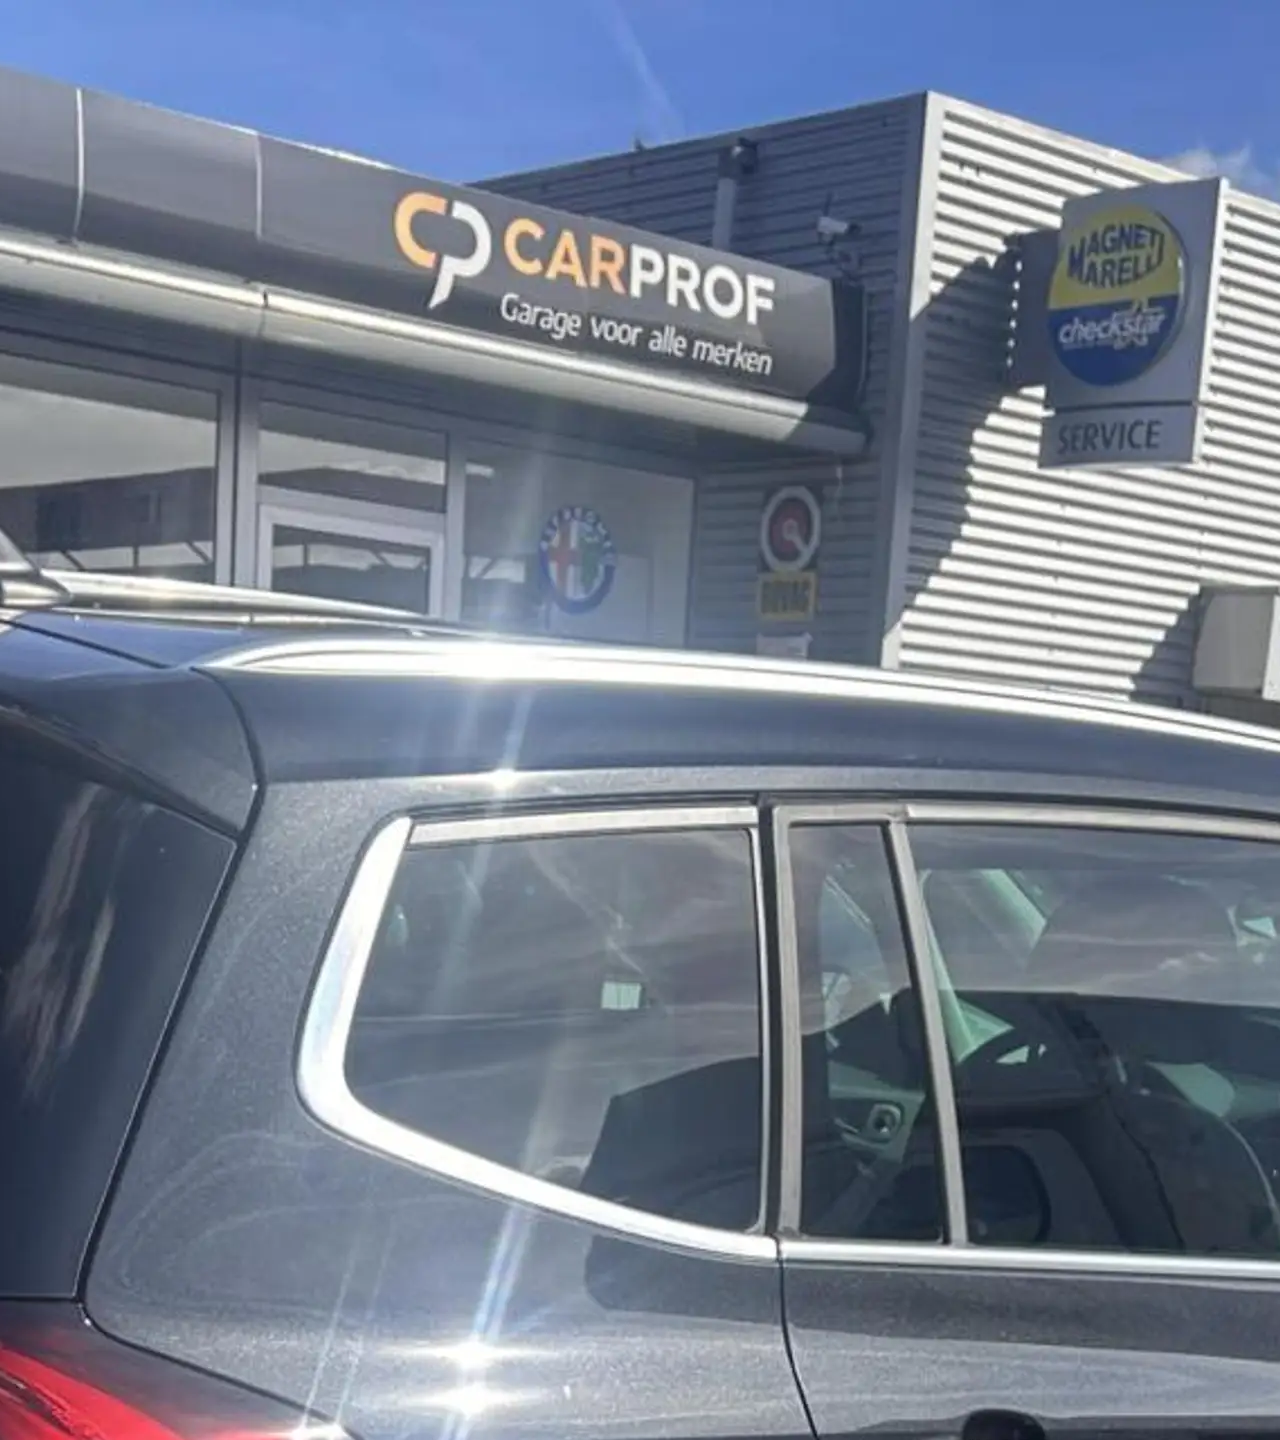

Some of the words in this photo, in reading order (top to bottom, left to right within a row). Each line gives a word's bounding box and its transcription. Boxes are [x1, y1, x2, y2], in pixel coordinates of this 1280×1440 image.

[504, 219, 776, 326] CARPROF
[501, 293, 581, 340] Garage
[591, 316, 643, 347] voor
[648, 327, 687, 358] alle
[692, 340, 772, 376] merken
[1057, 419, 1163, 454] SERVICE
